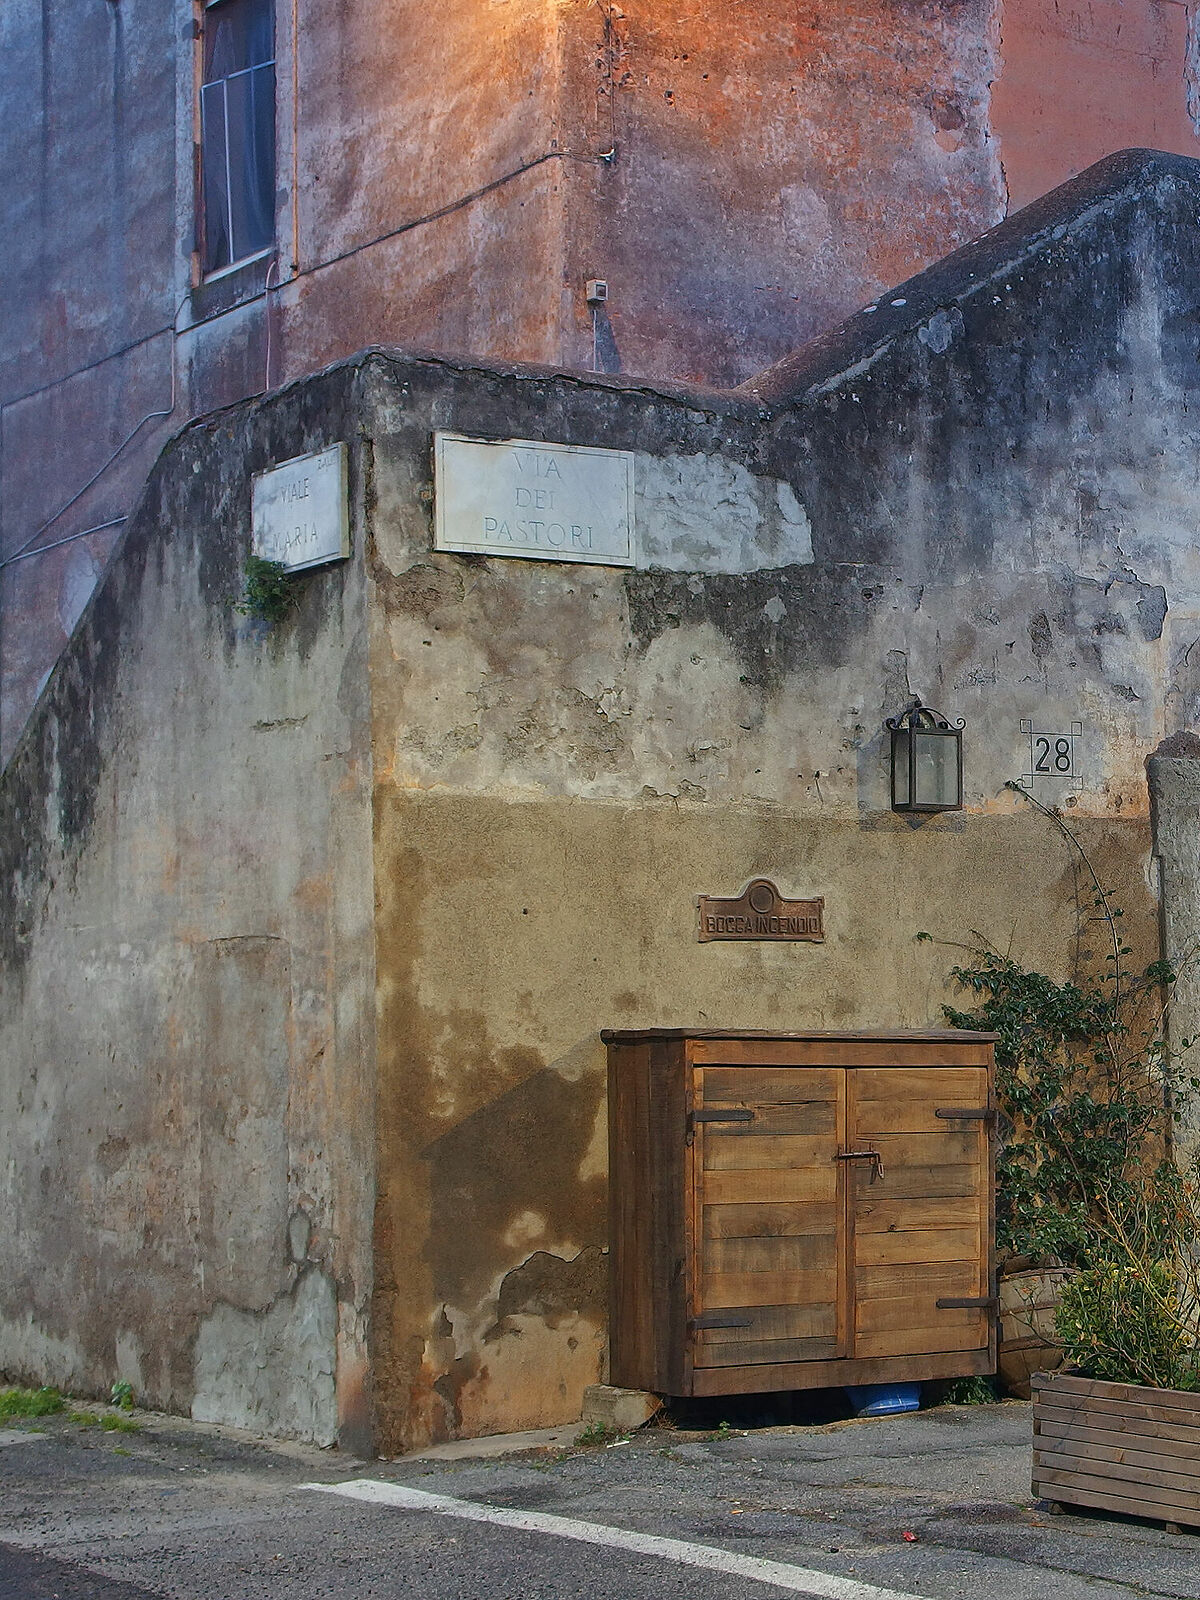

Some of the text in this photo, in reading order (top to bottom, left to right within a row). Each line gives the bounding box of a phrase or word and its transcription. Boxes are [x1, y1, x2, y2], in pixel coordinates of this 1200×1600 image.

[512, 452, 562, 479] VIA
[280, 477, 309, 503] VIALE
[515, 487, 555, 510] DEI
[273, 522, 318, 552] MARIA
[484, 517, 593, 549] PASTORI
[1035, 737, 1071, 772] 28
[706, 914, 818, 934] BOCCA INCENDIO
